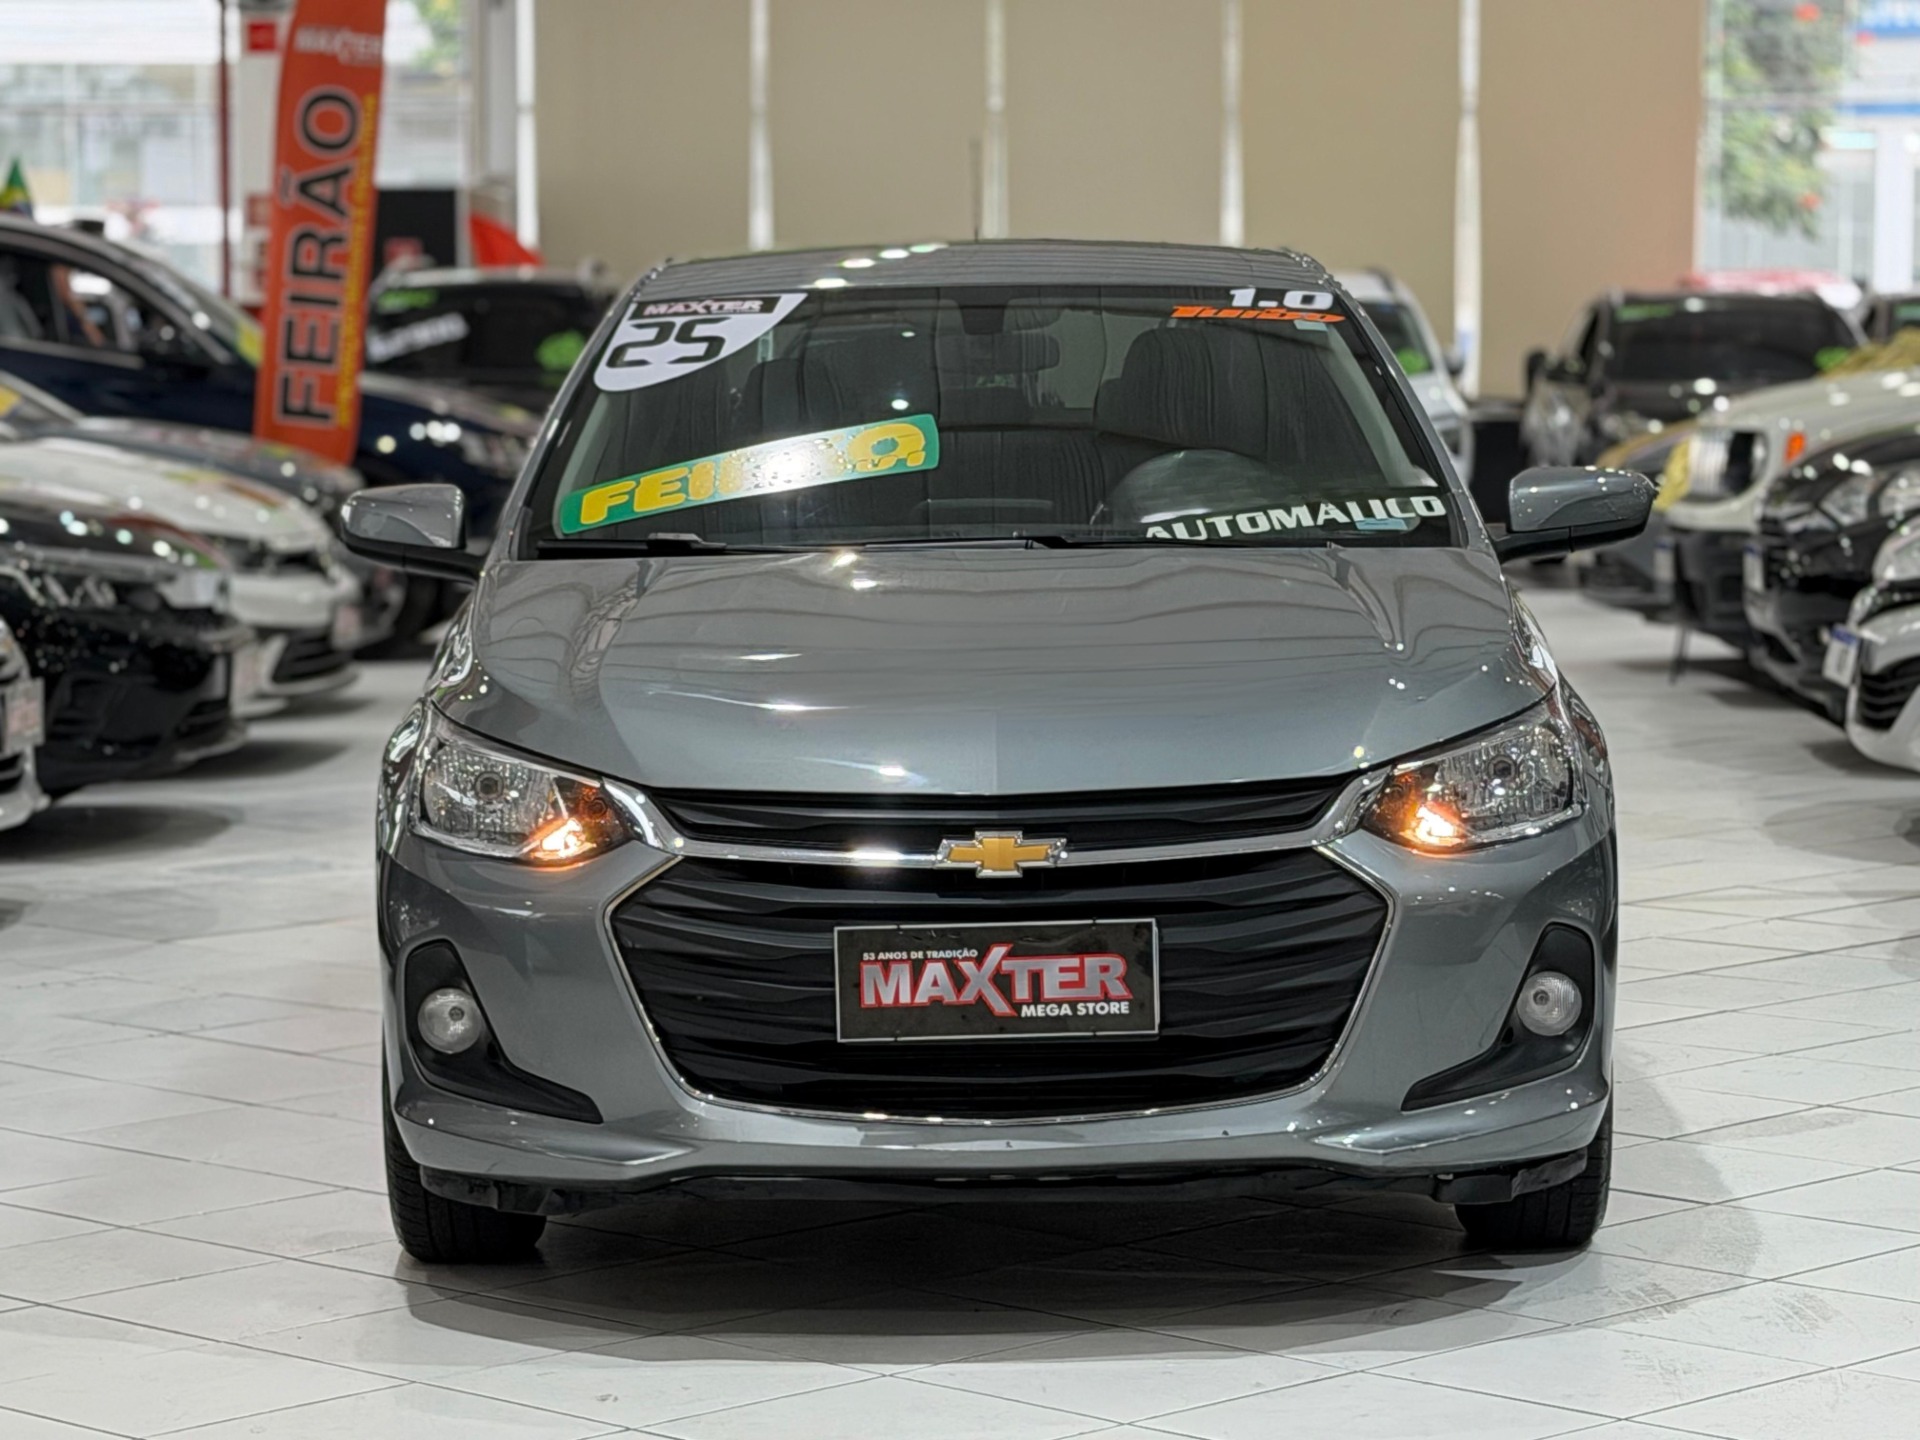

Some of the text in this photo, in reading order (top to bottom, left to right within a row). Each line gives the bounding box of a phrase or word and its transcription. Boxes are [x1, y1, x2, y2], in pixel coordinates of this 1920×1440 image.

[274, 85, 361, 429] FEIRÃO
[643, 299, 763, 316] MAXTER
[1229, 288, 1334, 309] 1.0
[606, 317, 732, 368] 25
[863, 948, 978, 961] 53 ANOS DE TRADIÇÃO
[860, 942, 1133, 1017] MAXTER
[1021, 1001, 1130, 1018] MEGA STORE
